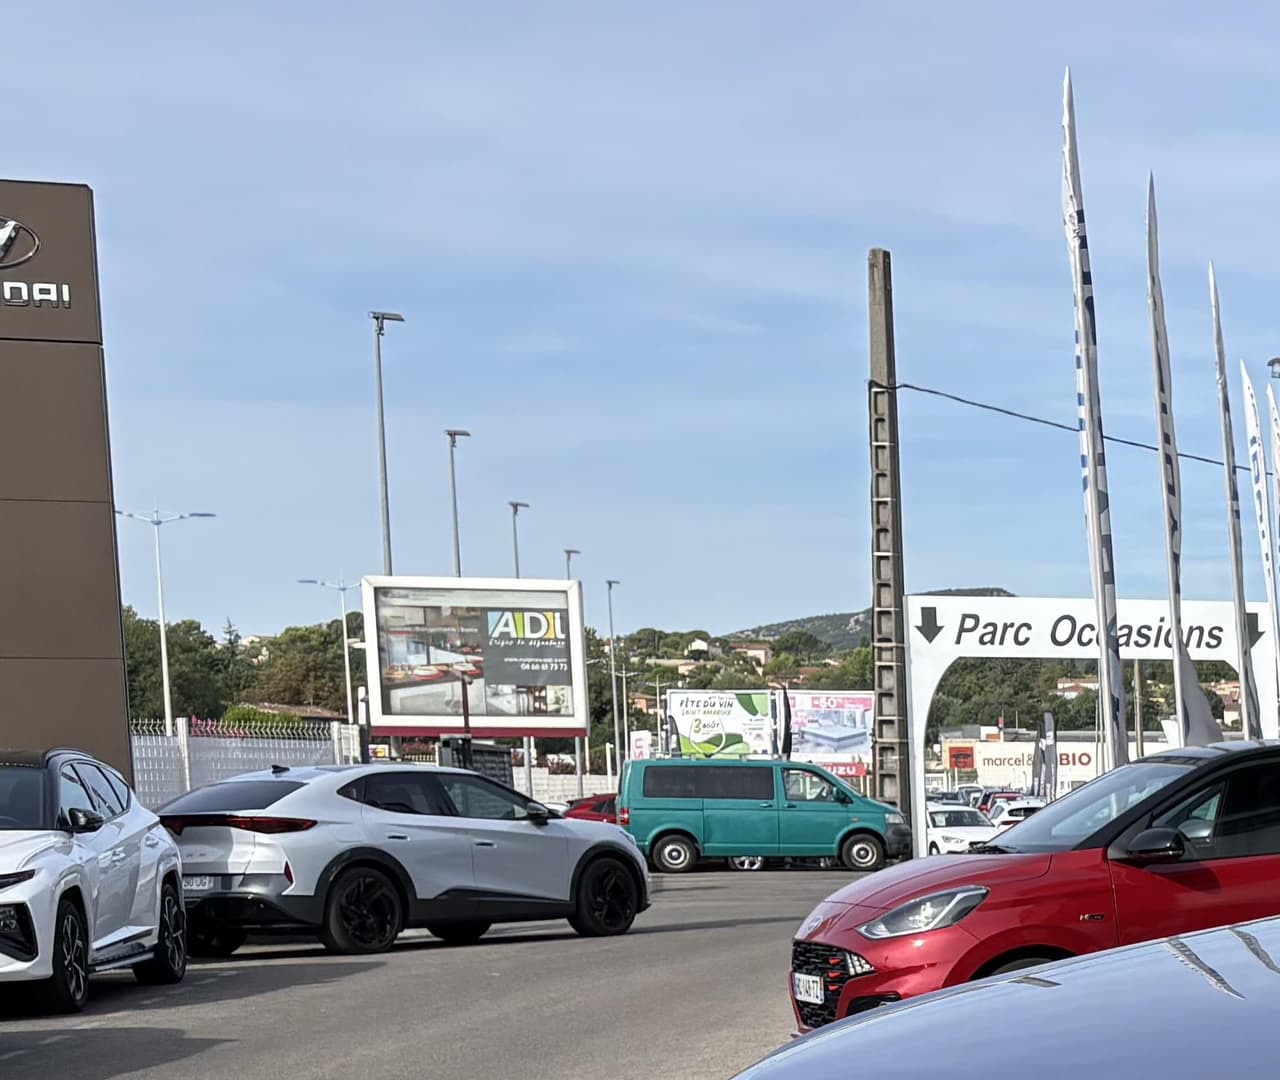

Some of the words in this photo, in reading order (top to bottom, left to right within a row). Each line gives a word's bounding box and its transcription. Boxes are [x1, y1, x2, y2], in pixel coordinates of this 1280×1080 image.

[955, 613, 1032, 647] Parc
[1051, 614, 1224, 649] Ocasions
[703, 699, 716, 708] DU
[719, 700, 734, 708] VIN
[983, 752, 1024, 766] marcel
[1059, 752, 1091, 766] BIO
